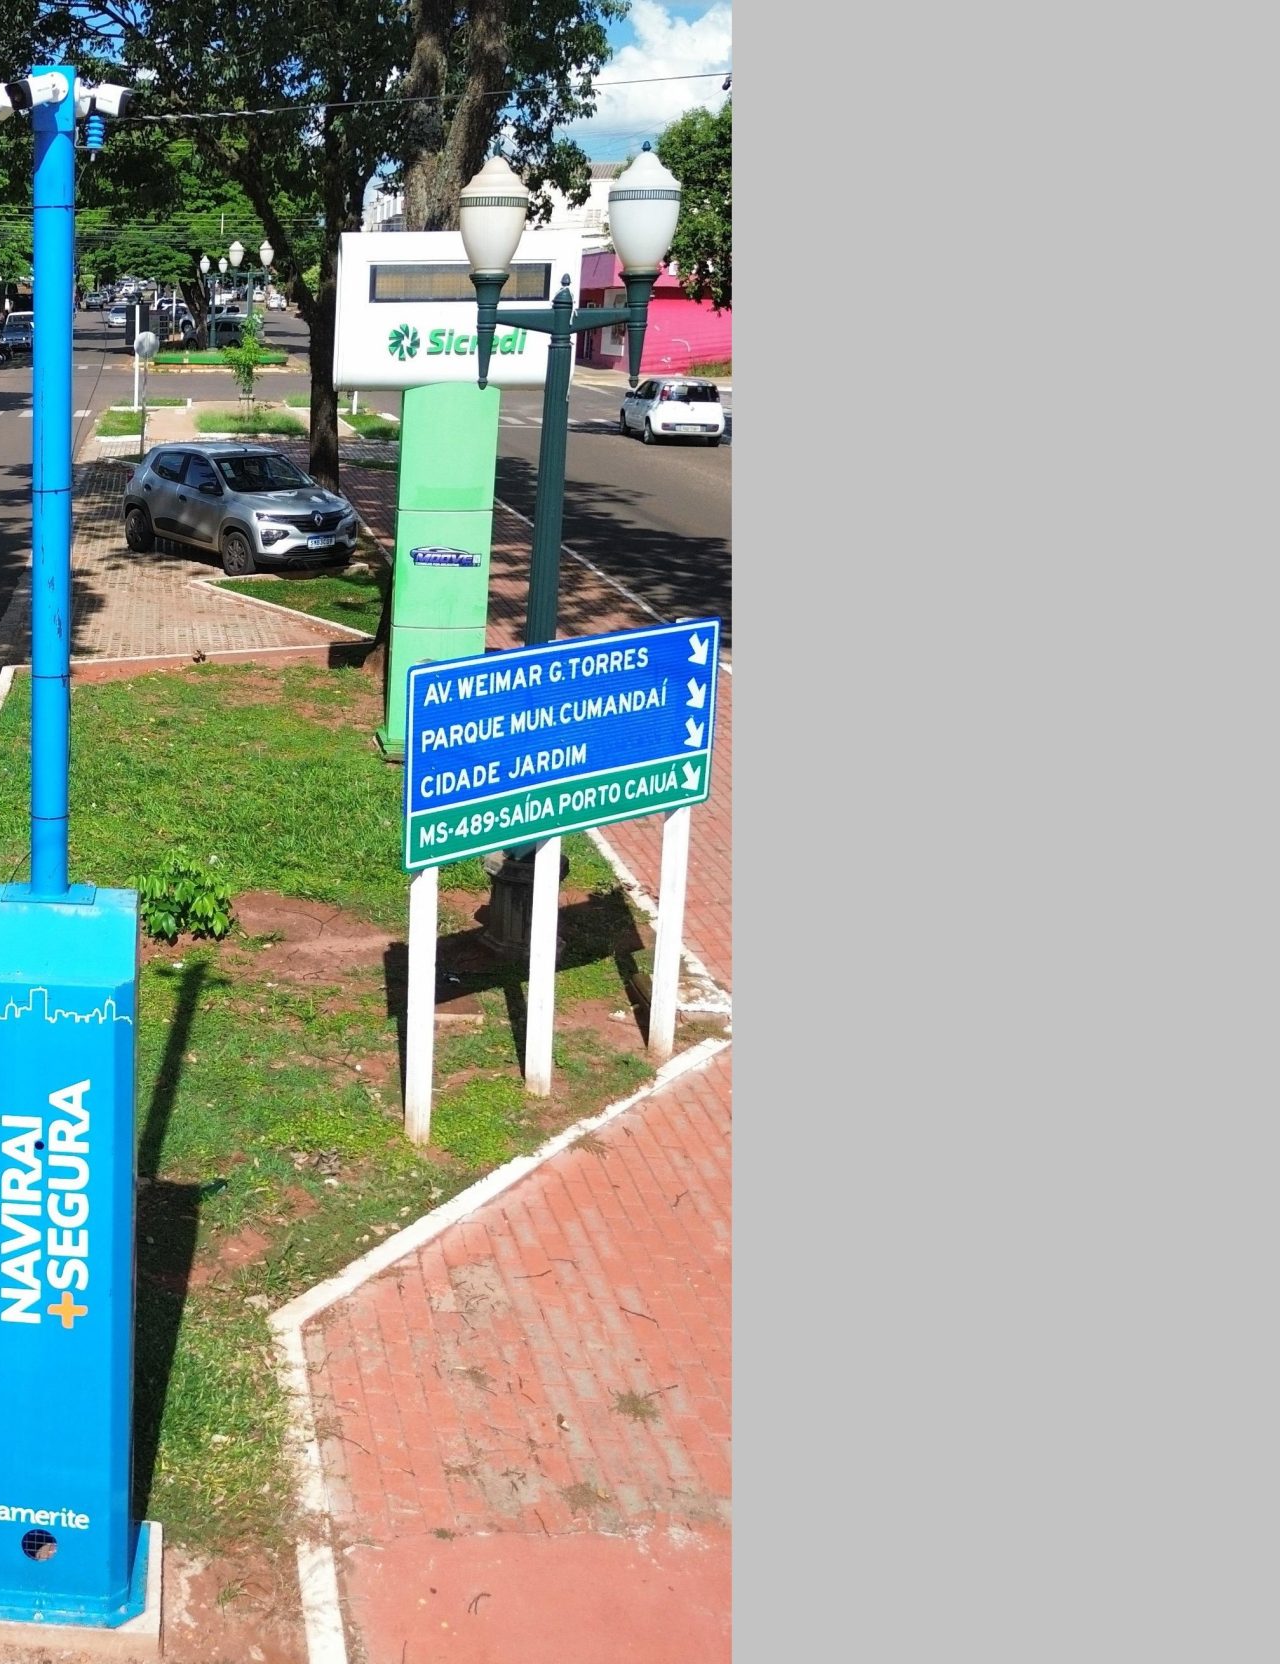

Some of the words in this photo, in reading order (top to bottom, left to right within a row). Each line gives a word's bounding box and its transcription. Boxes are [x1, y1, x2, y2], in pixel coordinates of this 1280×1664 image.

[423, 680, 453, 707] AV.
[457, 665, 542, 700] WEIMAR
[421, 715, 505, 753] PARQUE
[420, 761, 500, 798] CIDADE
[508, 743, 587, 779] JARDIM
[558, 783, 621, 815] PORTO
[624, 763, 678, 800] CAIUÁ
